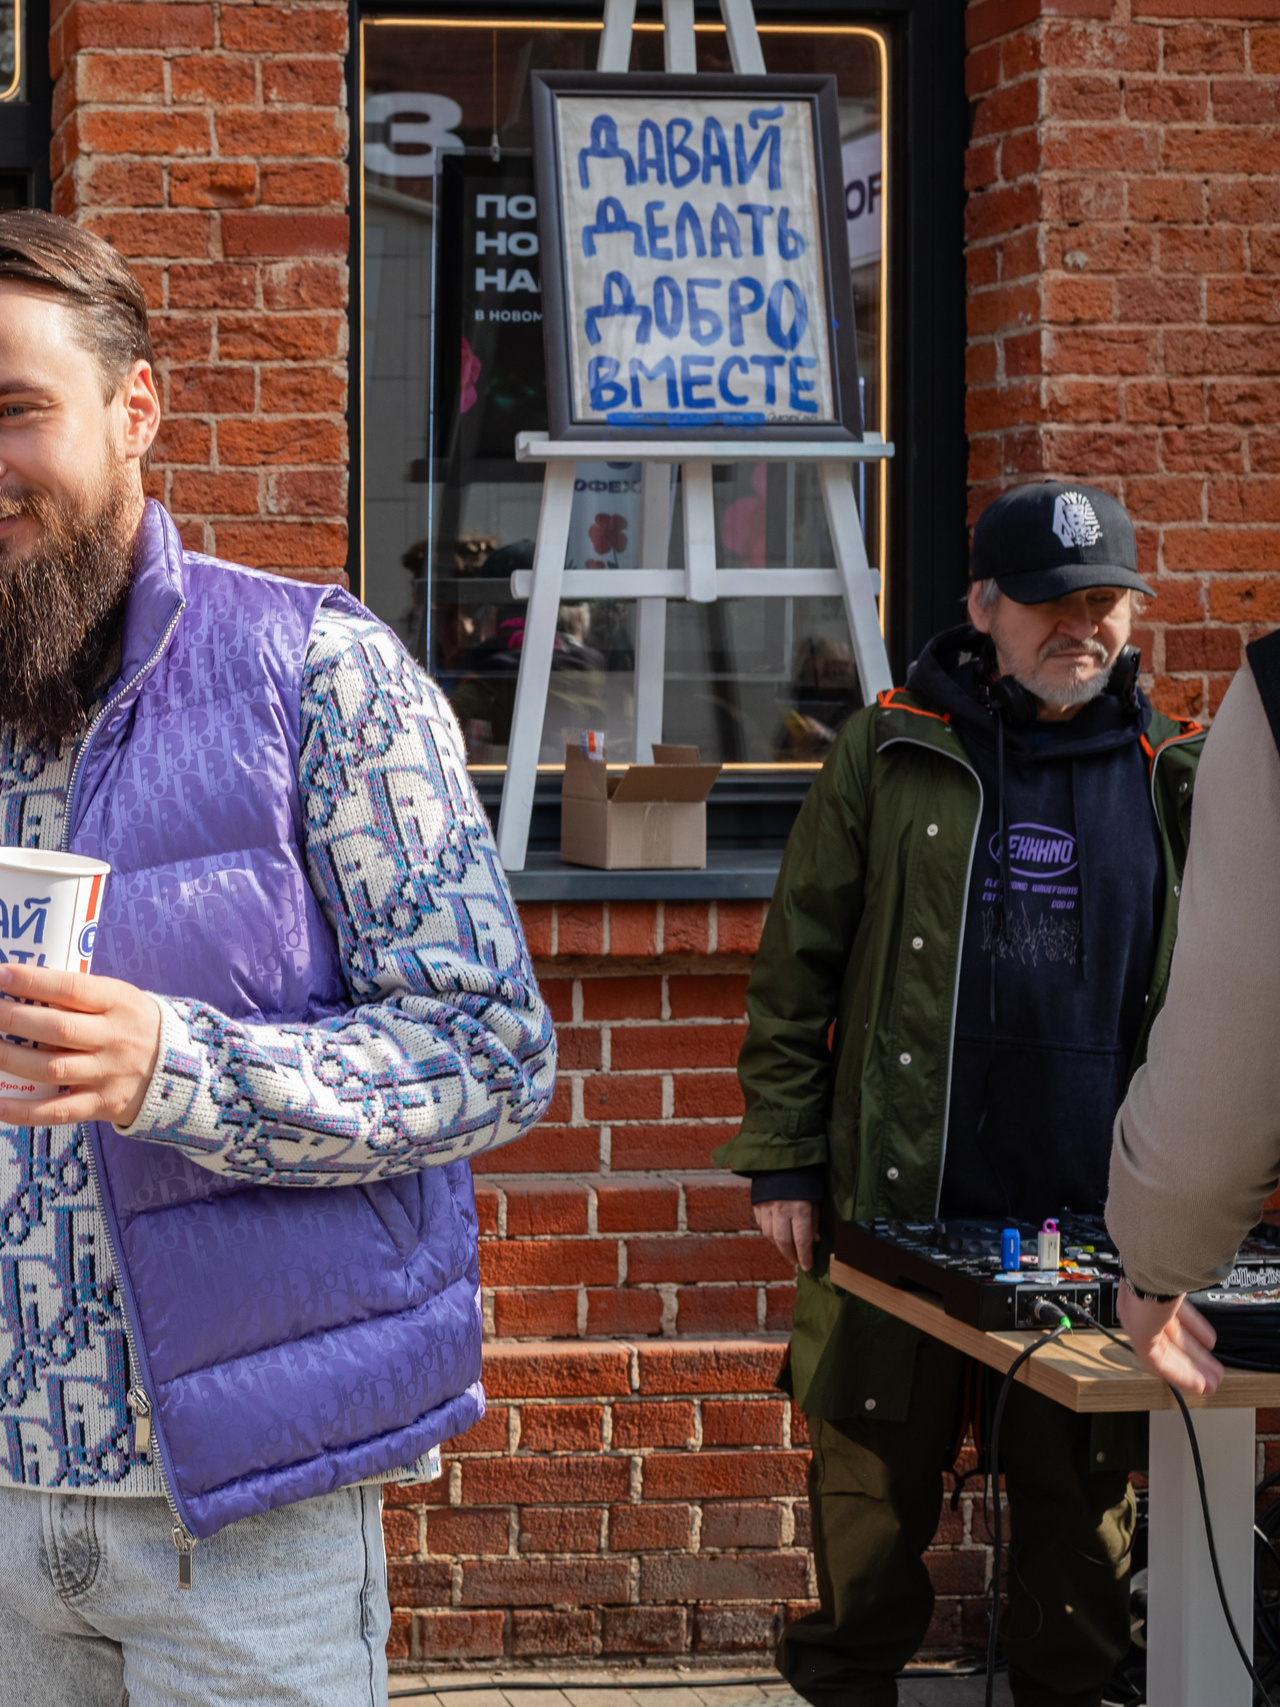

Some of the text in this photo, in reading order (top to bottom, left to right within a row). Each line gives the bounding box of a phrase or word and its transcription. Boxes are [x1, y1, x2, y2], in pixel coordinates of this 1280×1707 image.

[578, 105, 784, 190] ДАВАЙ
[582, 196, 806, 261] ДЕЛАТЬ
[475, 267, 541, 292] НА
[475, 309, 485, 321] В
[584, 271, 809, 351] ДОБРО
[588, 355, 818, 413] ВМЕСТЕ
